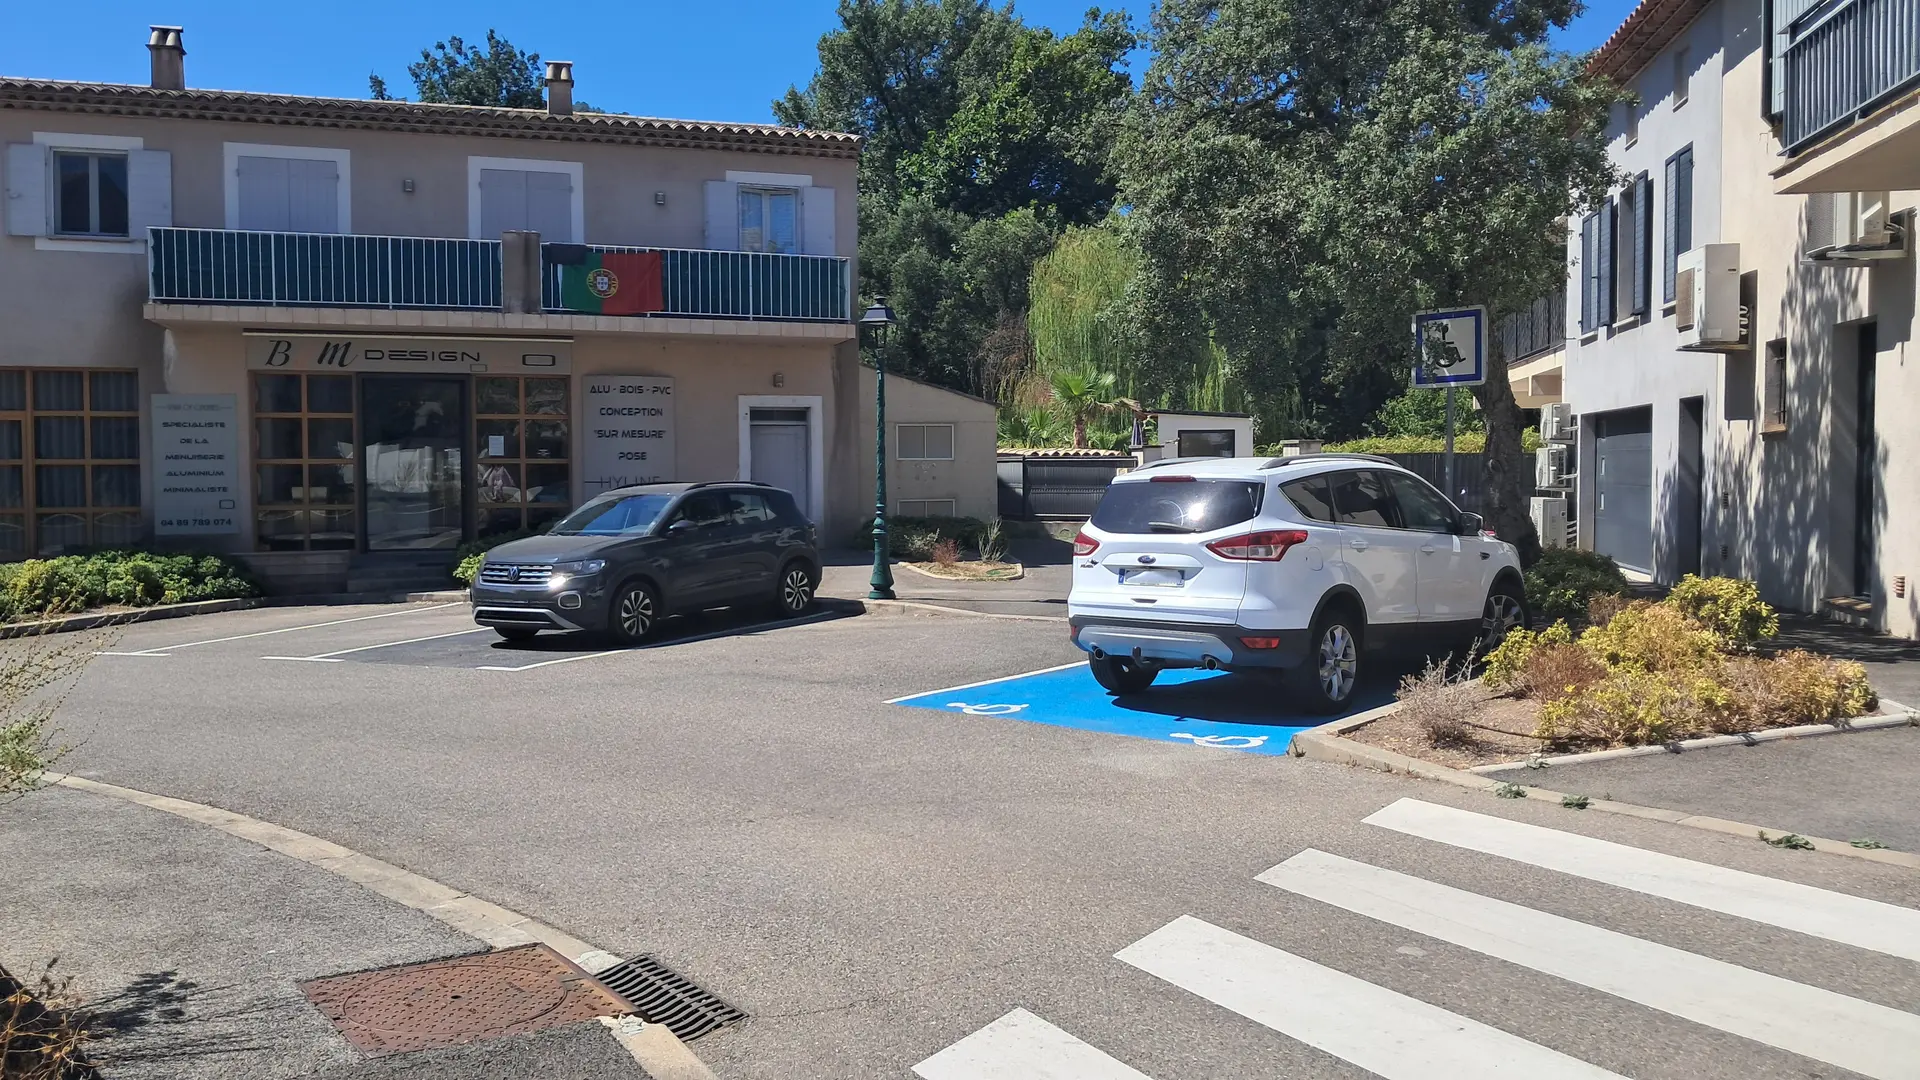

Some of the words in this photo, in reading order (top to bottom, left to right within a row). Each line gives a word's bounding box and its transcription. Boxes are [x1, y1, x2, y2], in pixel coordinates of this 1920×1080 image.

[265, 340, 292, 367] B
[365, 349, 480, 362] DESIGN
[590, 384, 611, 394] ALU
[620, 385, 645, 394] BOIS
[652, 386, 671, 395] PVC
[600, 407, 664, 416] CONCEPTION
[618, 452, 647, 461] POSE
[213, 518, 232, 526] 074
